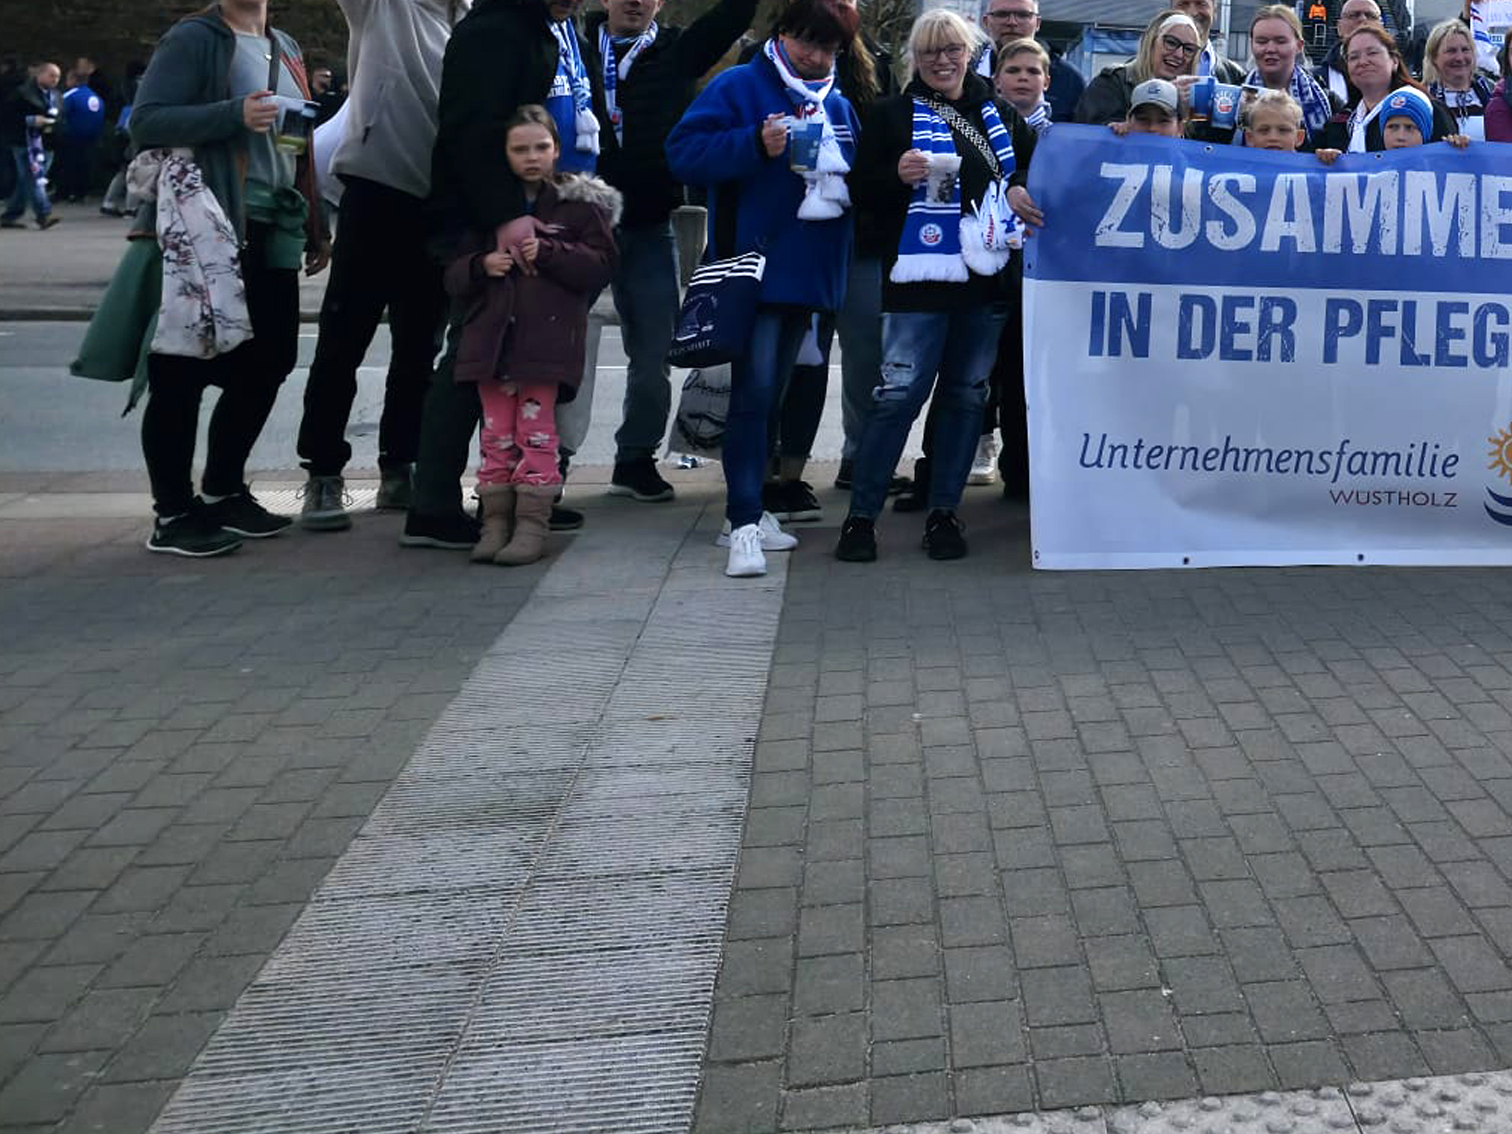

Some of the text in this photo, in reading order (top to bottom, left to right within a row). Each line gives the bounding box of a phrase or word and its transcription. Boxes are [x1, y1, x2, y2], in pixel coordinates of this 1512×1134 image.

[1089, 290, 1152, 359] IN
[1177, 293, 1297, 364] DER
[1078, 433, 1460, 484] Unternehmensfamilie
